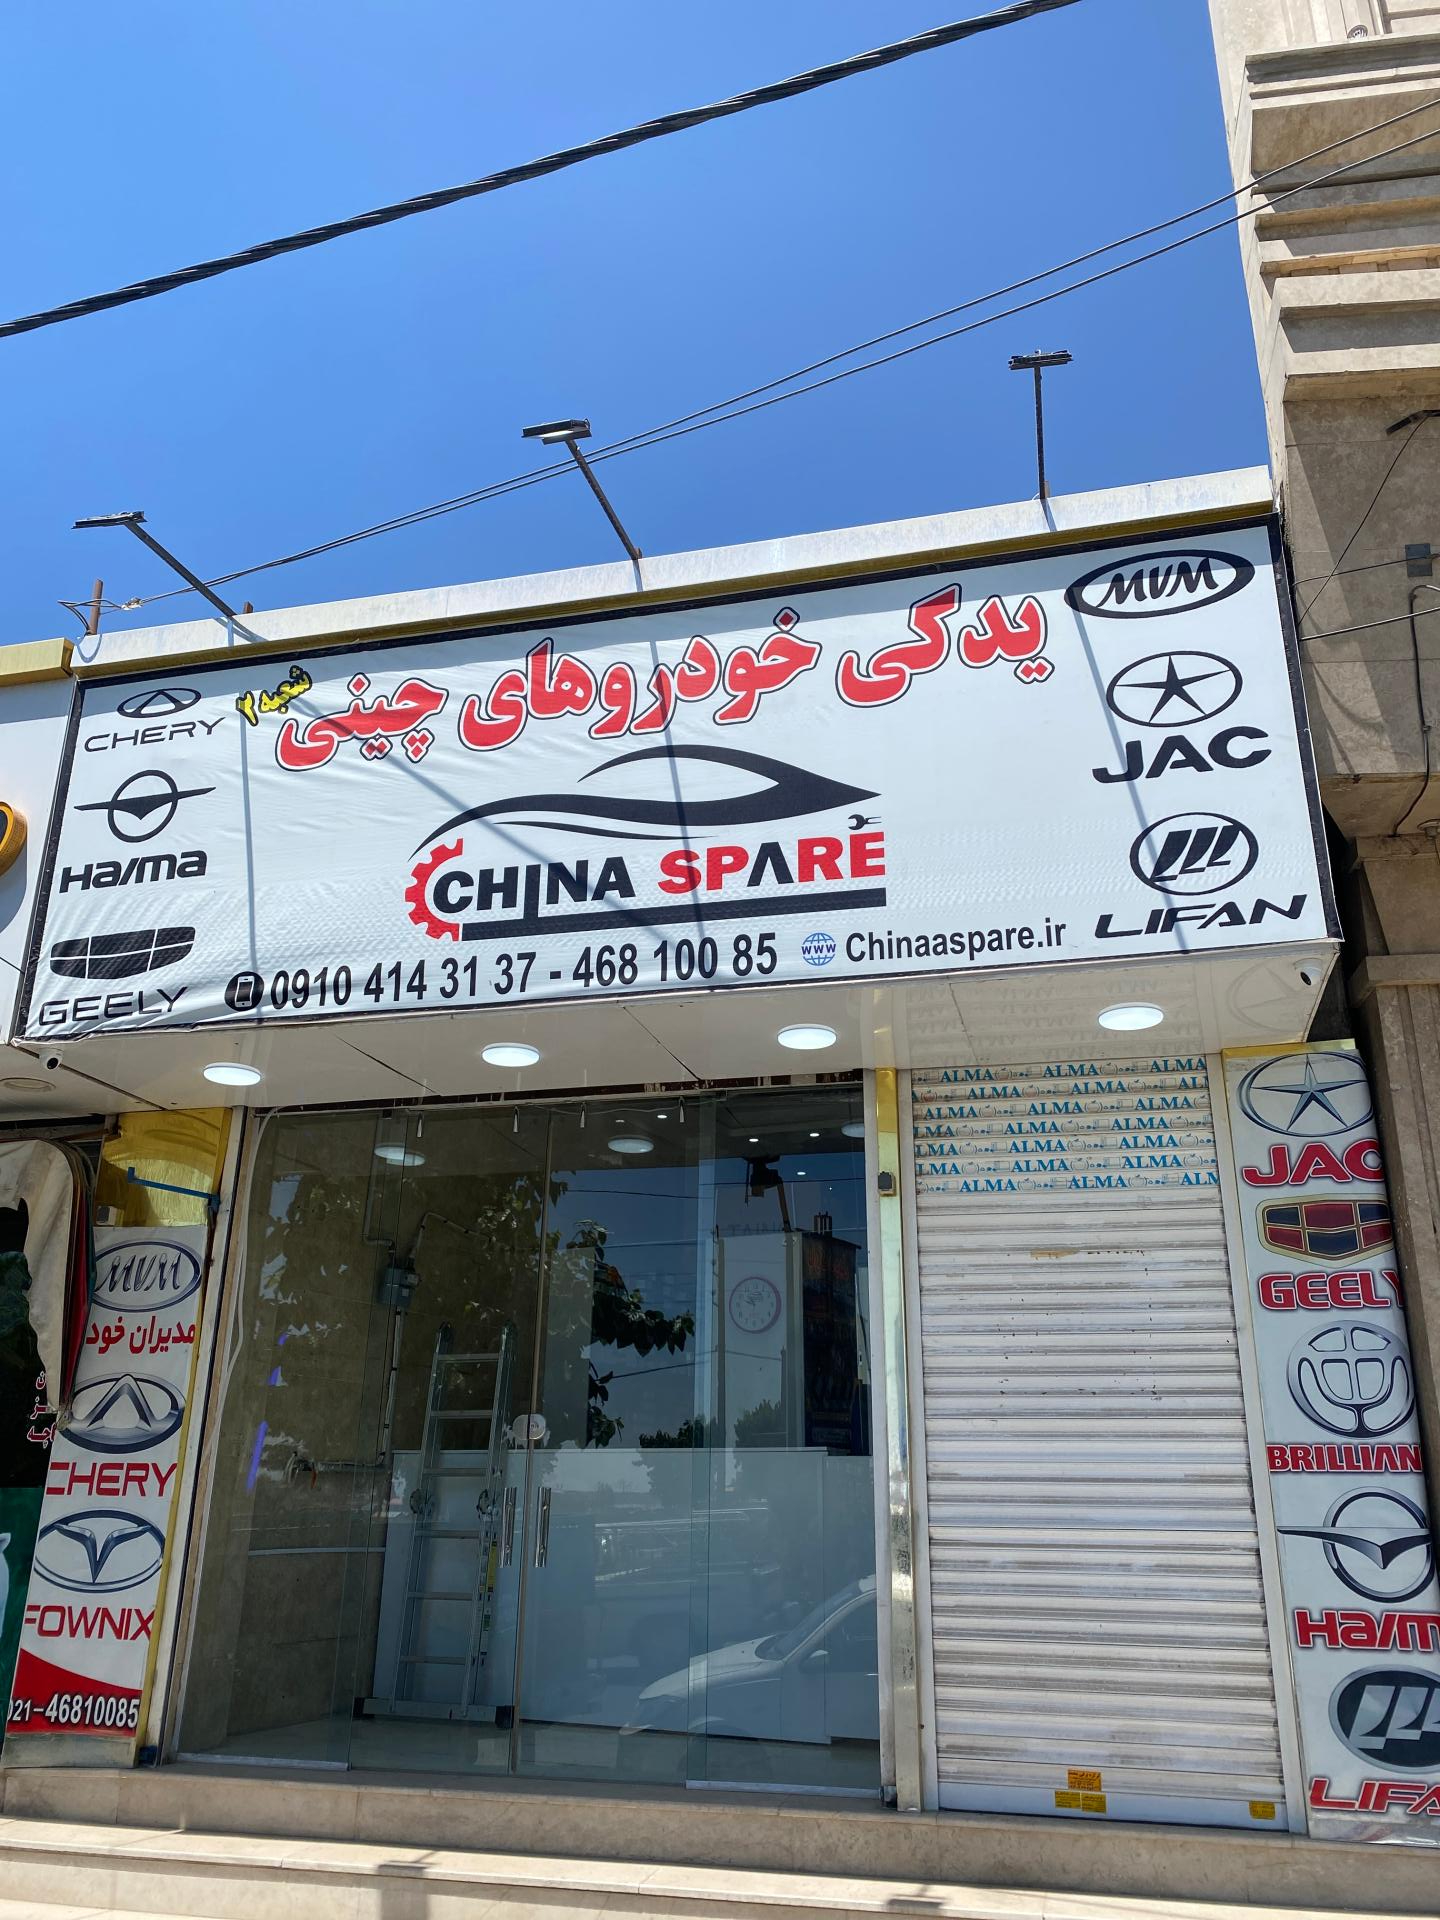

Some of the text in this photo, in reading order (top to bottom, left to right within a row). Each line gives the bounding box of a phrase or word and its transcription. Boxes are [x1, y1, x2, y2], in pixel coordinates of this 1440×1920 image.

[1094, 556, 1221, 607] MVM
[259, 665, 313, 714] شعبه
[275, 584, 1055, 772] یدکی خودروهای چینی
[84, 717, 225, 753] CHERY
[1092, 725, 1272, 784] JAC
[433, 831, 887, 918] CHINA SPARE
[1094, 894, 1308, 939] LIFAN
[845, 917, 1067, 962] Chinaaspare.ir
[270, 964, 352, 1011] 0910
[364, 958, 427, 1003] 414
[439, 955, 478, 999] 31
[493, 951, 536, 995] 37
[573, 943, 638, 988] 468
[653, 937, 718, 982] 100
[732, 932, 778, 975] 85
[39, 986, 188, 1027] GEELY
[941, 1058, 1206, 1083] ALMA ALMA ALMA
[968, 1085, 1022, 1100] ALMA
[1071, 1080, 1127, 1095] ALMA
[924, 1096, 1195, 1120] ALMA ALMA ALMA
[1004, 1120, 1060, 1135] ALMA
[1111, 1116, 1170, 1131] ALMA
[1008, 1138, 1067, 1153] ALMA
[1119, 1134, 1178, 1149] ALMA
[1011, 1157, 1070, 1172] ALMA
[1122, 1154, 1183, 1169] ALMA
[1242, 1138, 1386, 1186] JAC
[960, 1178, 1017, 1193] ALMA
[1068, 1174, 1128, 1189] ALMA
